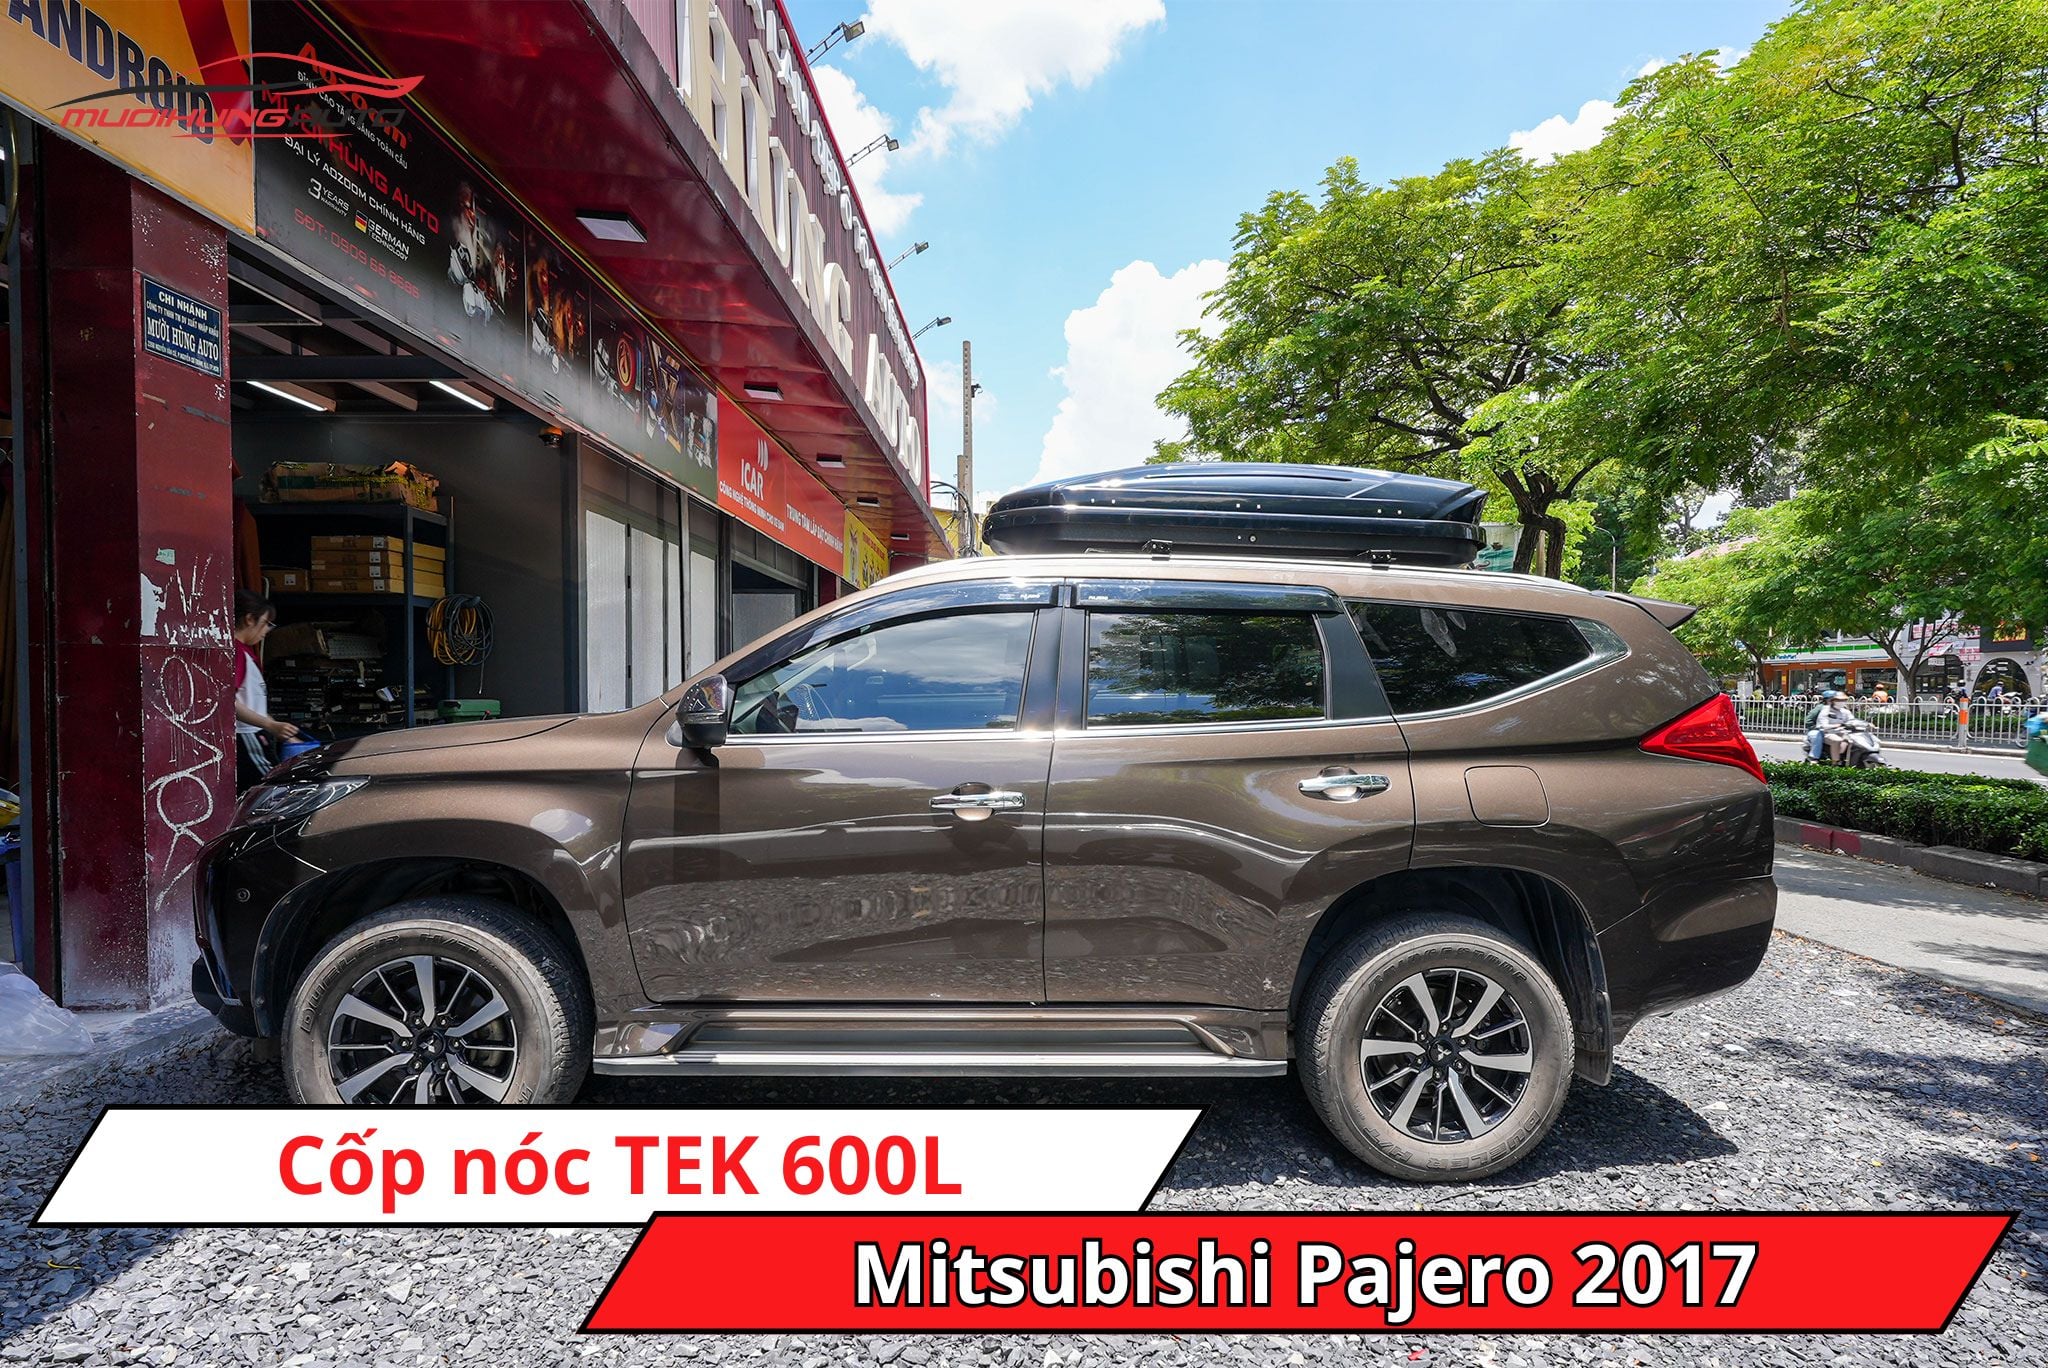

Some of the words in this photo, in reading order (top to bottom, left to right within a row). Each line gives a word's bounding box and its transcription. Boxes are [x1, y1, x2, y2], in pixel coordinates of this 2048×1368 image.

[7, 0, 214, 145] ANDROID
[284, 134, 304, 156] ĐẠI
[306, 149, 321, 166] LÝ
[368, 197, 399, 226] CHÍNH
[307, 177, 322, 200] 3
[322, 187, 349, 211] YEARS
[392, 187, 440, 235] AUTO
[367, 218, 410, 255] GERMAN
[158, 291, 175, 307] CHI
[176, 298, 208, 321] NHÁNH
[146, 316, 170, 343] MƯỜI
[171, 324, 196, 353] HÙNG
[197, 337, 219, 361] AUTO
[864, 333, 922, 487] AUTO
[741, 458, 764, 501] ICAR
